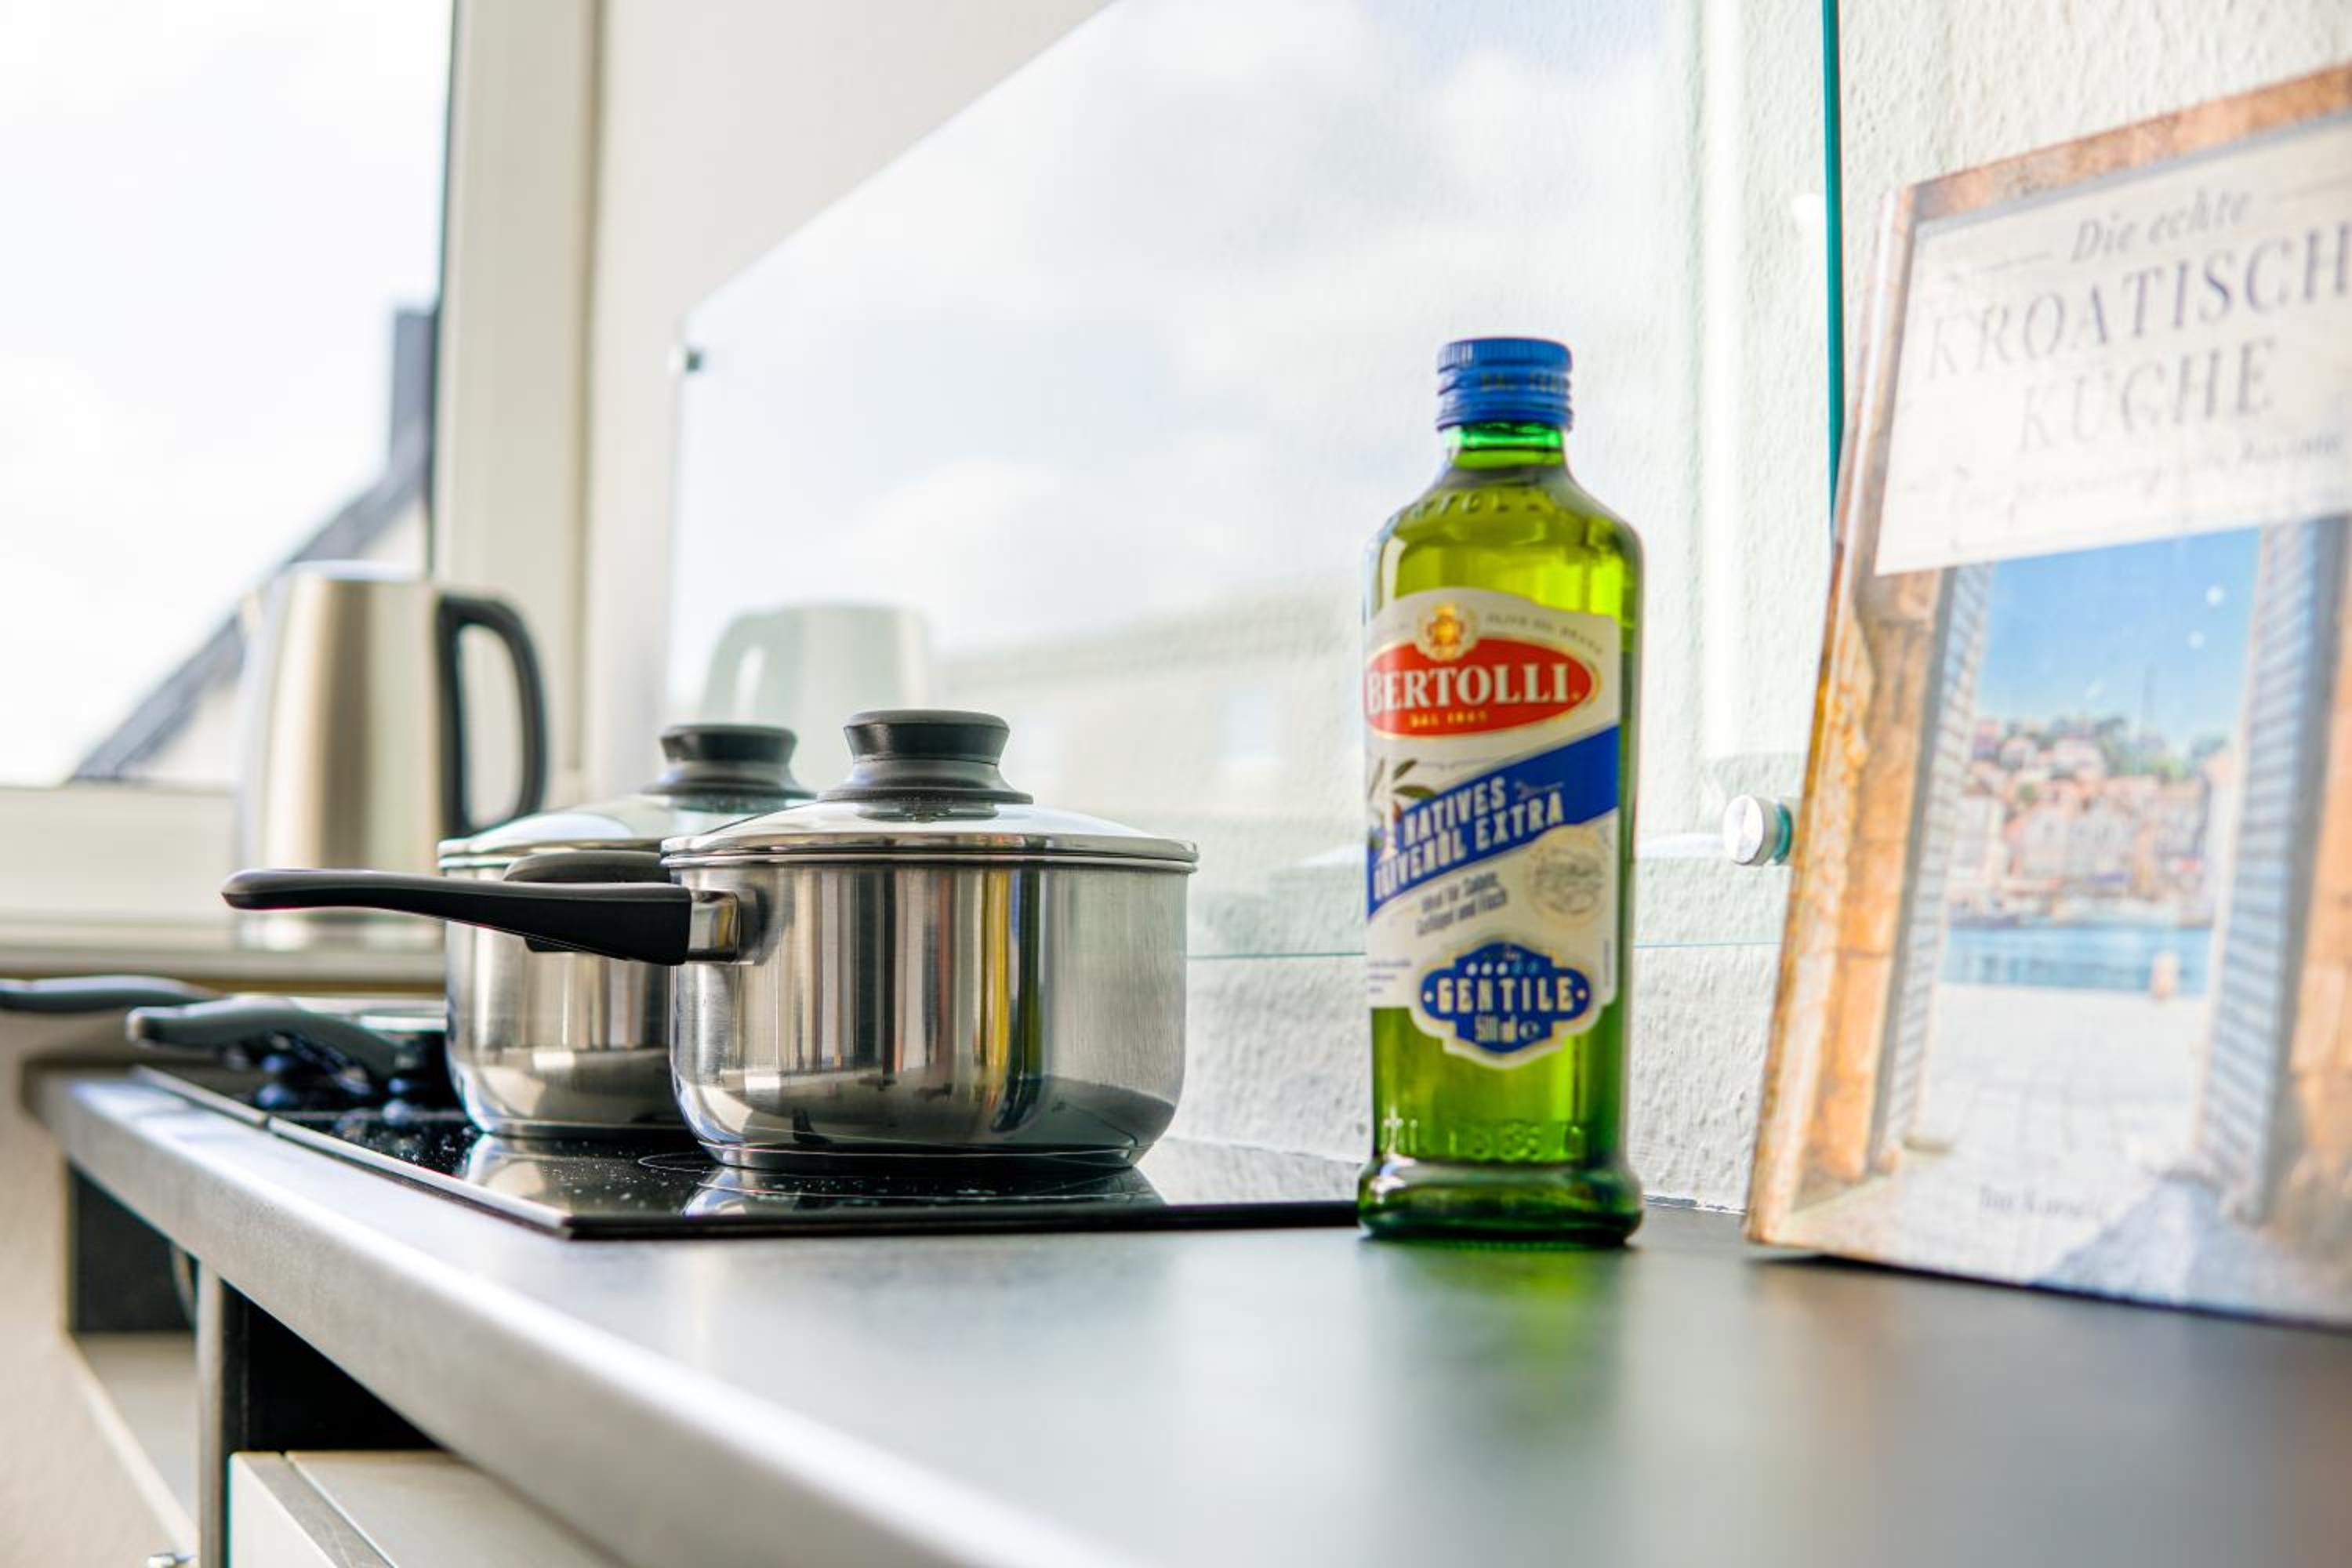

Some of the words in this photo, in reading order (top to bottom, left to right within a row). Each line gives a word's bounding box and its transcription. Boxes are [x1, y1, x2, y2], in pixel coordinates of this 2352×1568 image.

[1367, 663, 1570, 717] BERTOLLI
[1403, 775, 1507, 848] NATIVES
[1475, 791, 1565, 852] EXTRA
[1436, 976, 1574, 1014] GENTILE
